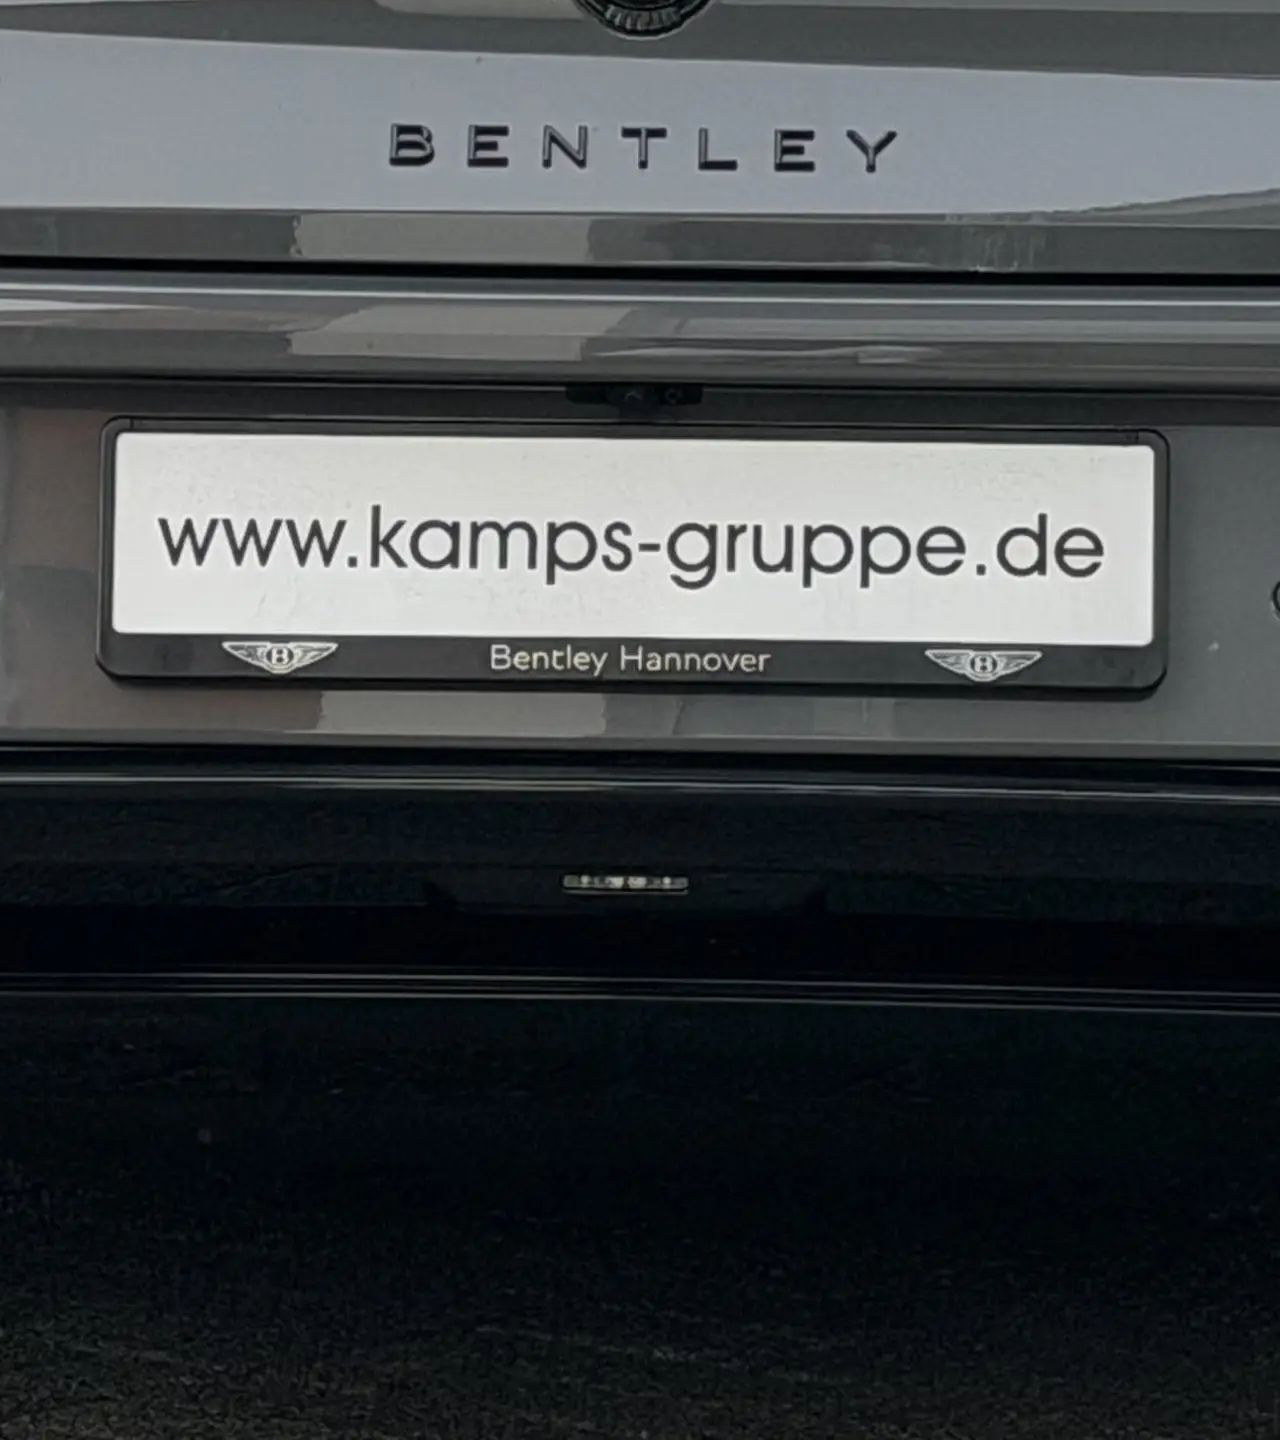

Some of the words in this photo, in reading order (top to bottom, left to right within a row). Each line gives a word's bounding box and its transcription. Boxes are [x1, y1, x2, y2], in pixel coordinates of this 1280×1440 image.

[389, 123, 897, 173] BENTLEY
[157, 504, 1105, 591] www.kamps-gruppe.de
[489, 645, 609, 677] Bentley
[620, 645, 772, 674] Hannover
